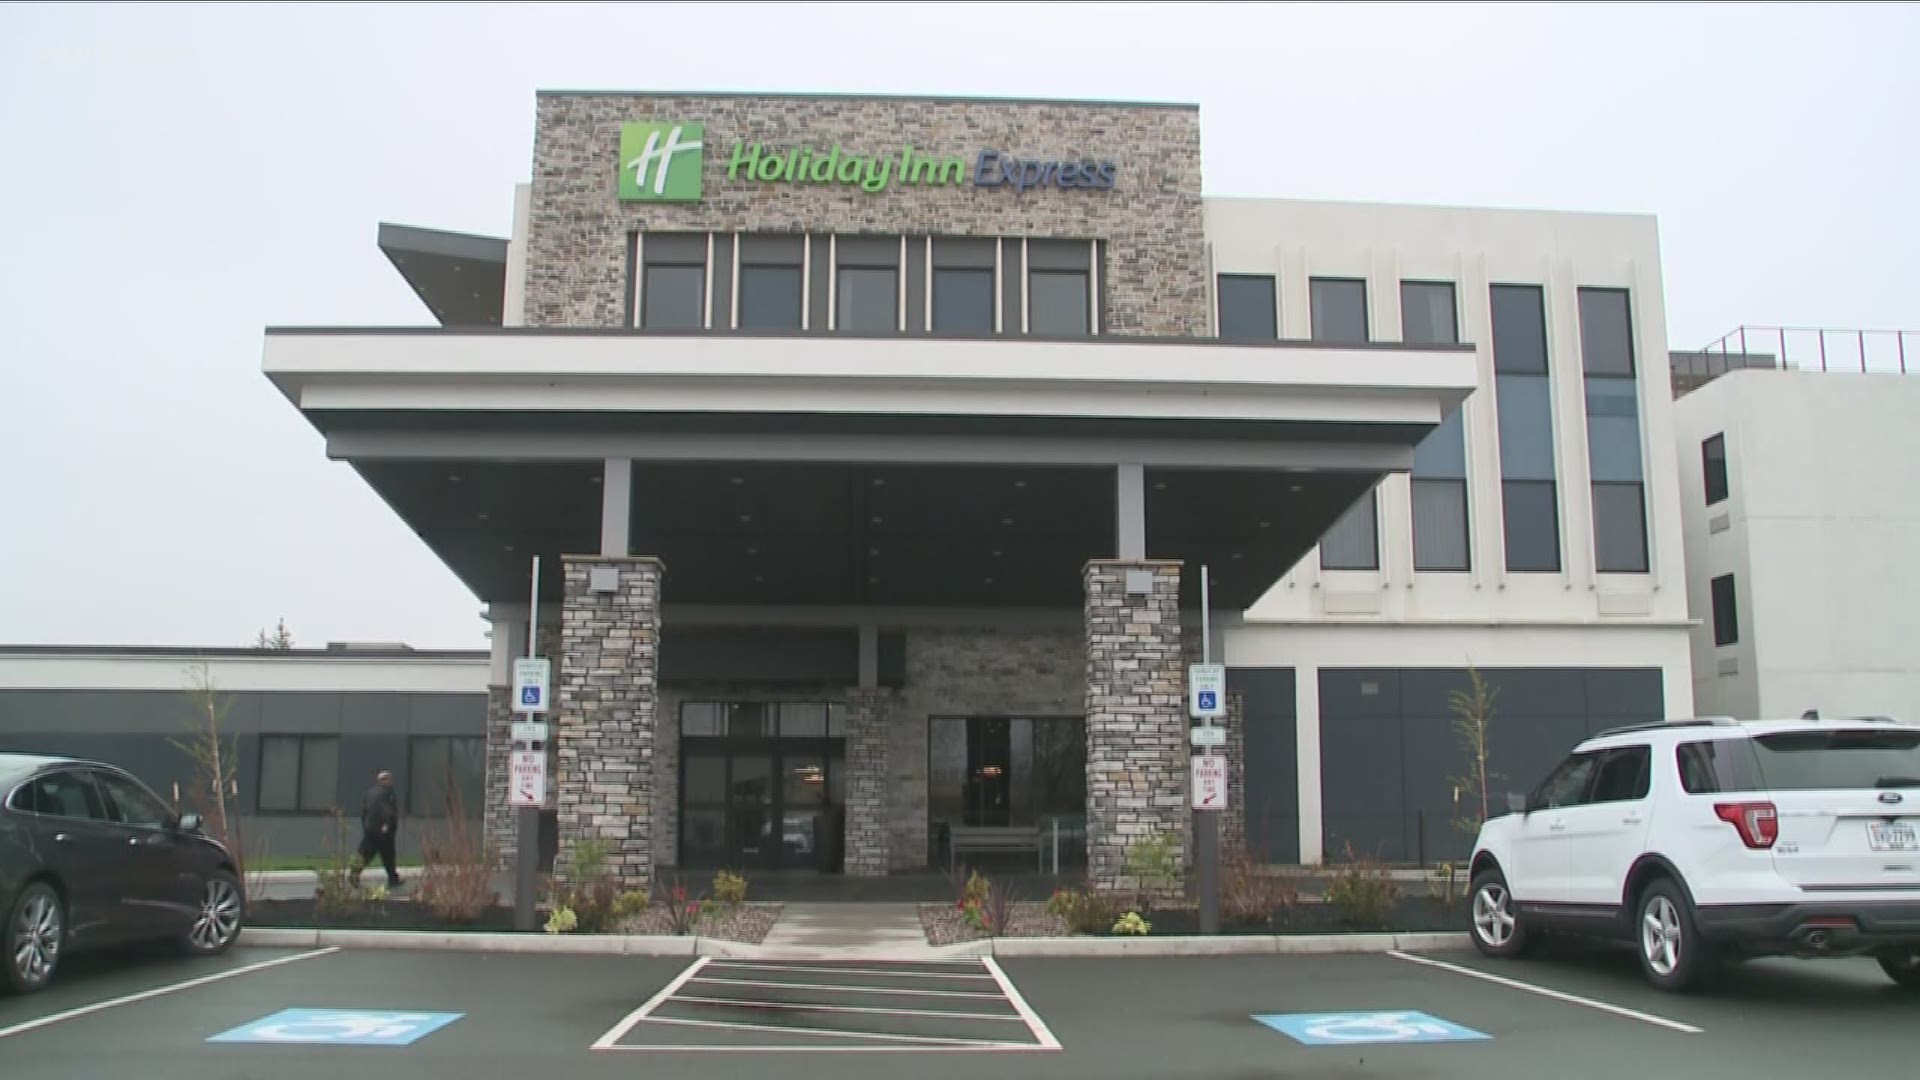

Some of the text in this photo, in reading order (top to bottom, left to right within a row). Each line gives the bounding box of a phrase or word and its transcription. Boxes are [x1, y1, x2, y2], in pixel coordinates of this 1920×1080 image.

[727, 141, 1117, 192] Holiday Inn Express
[522, 755, 535, 763] NO
[1203, 758, 1216, 768] NO
[514, 764, 541, 774] PARKING
[1196, 768, 1222, 779] PARKING
